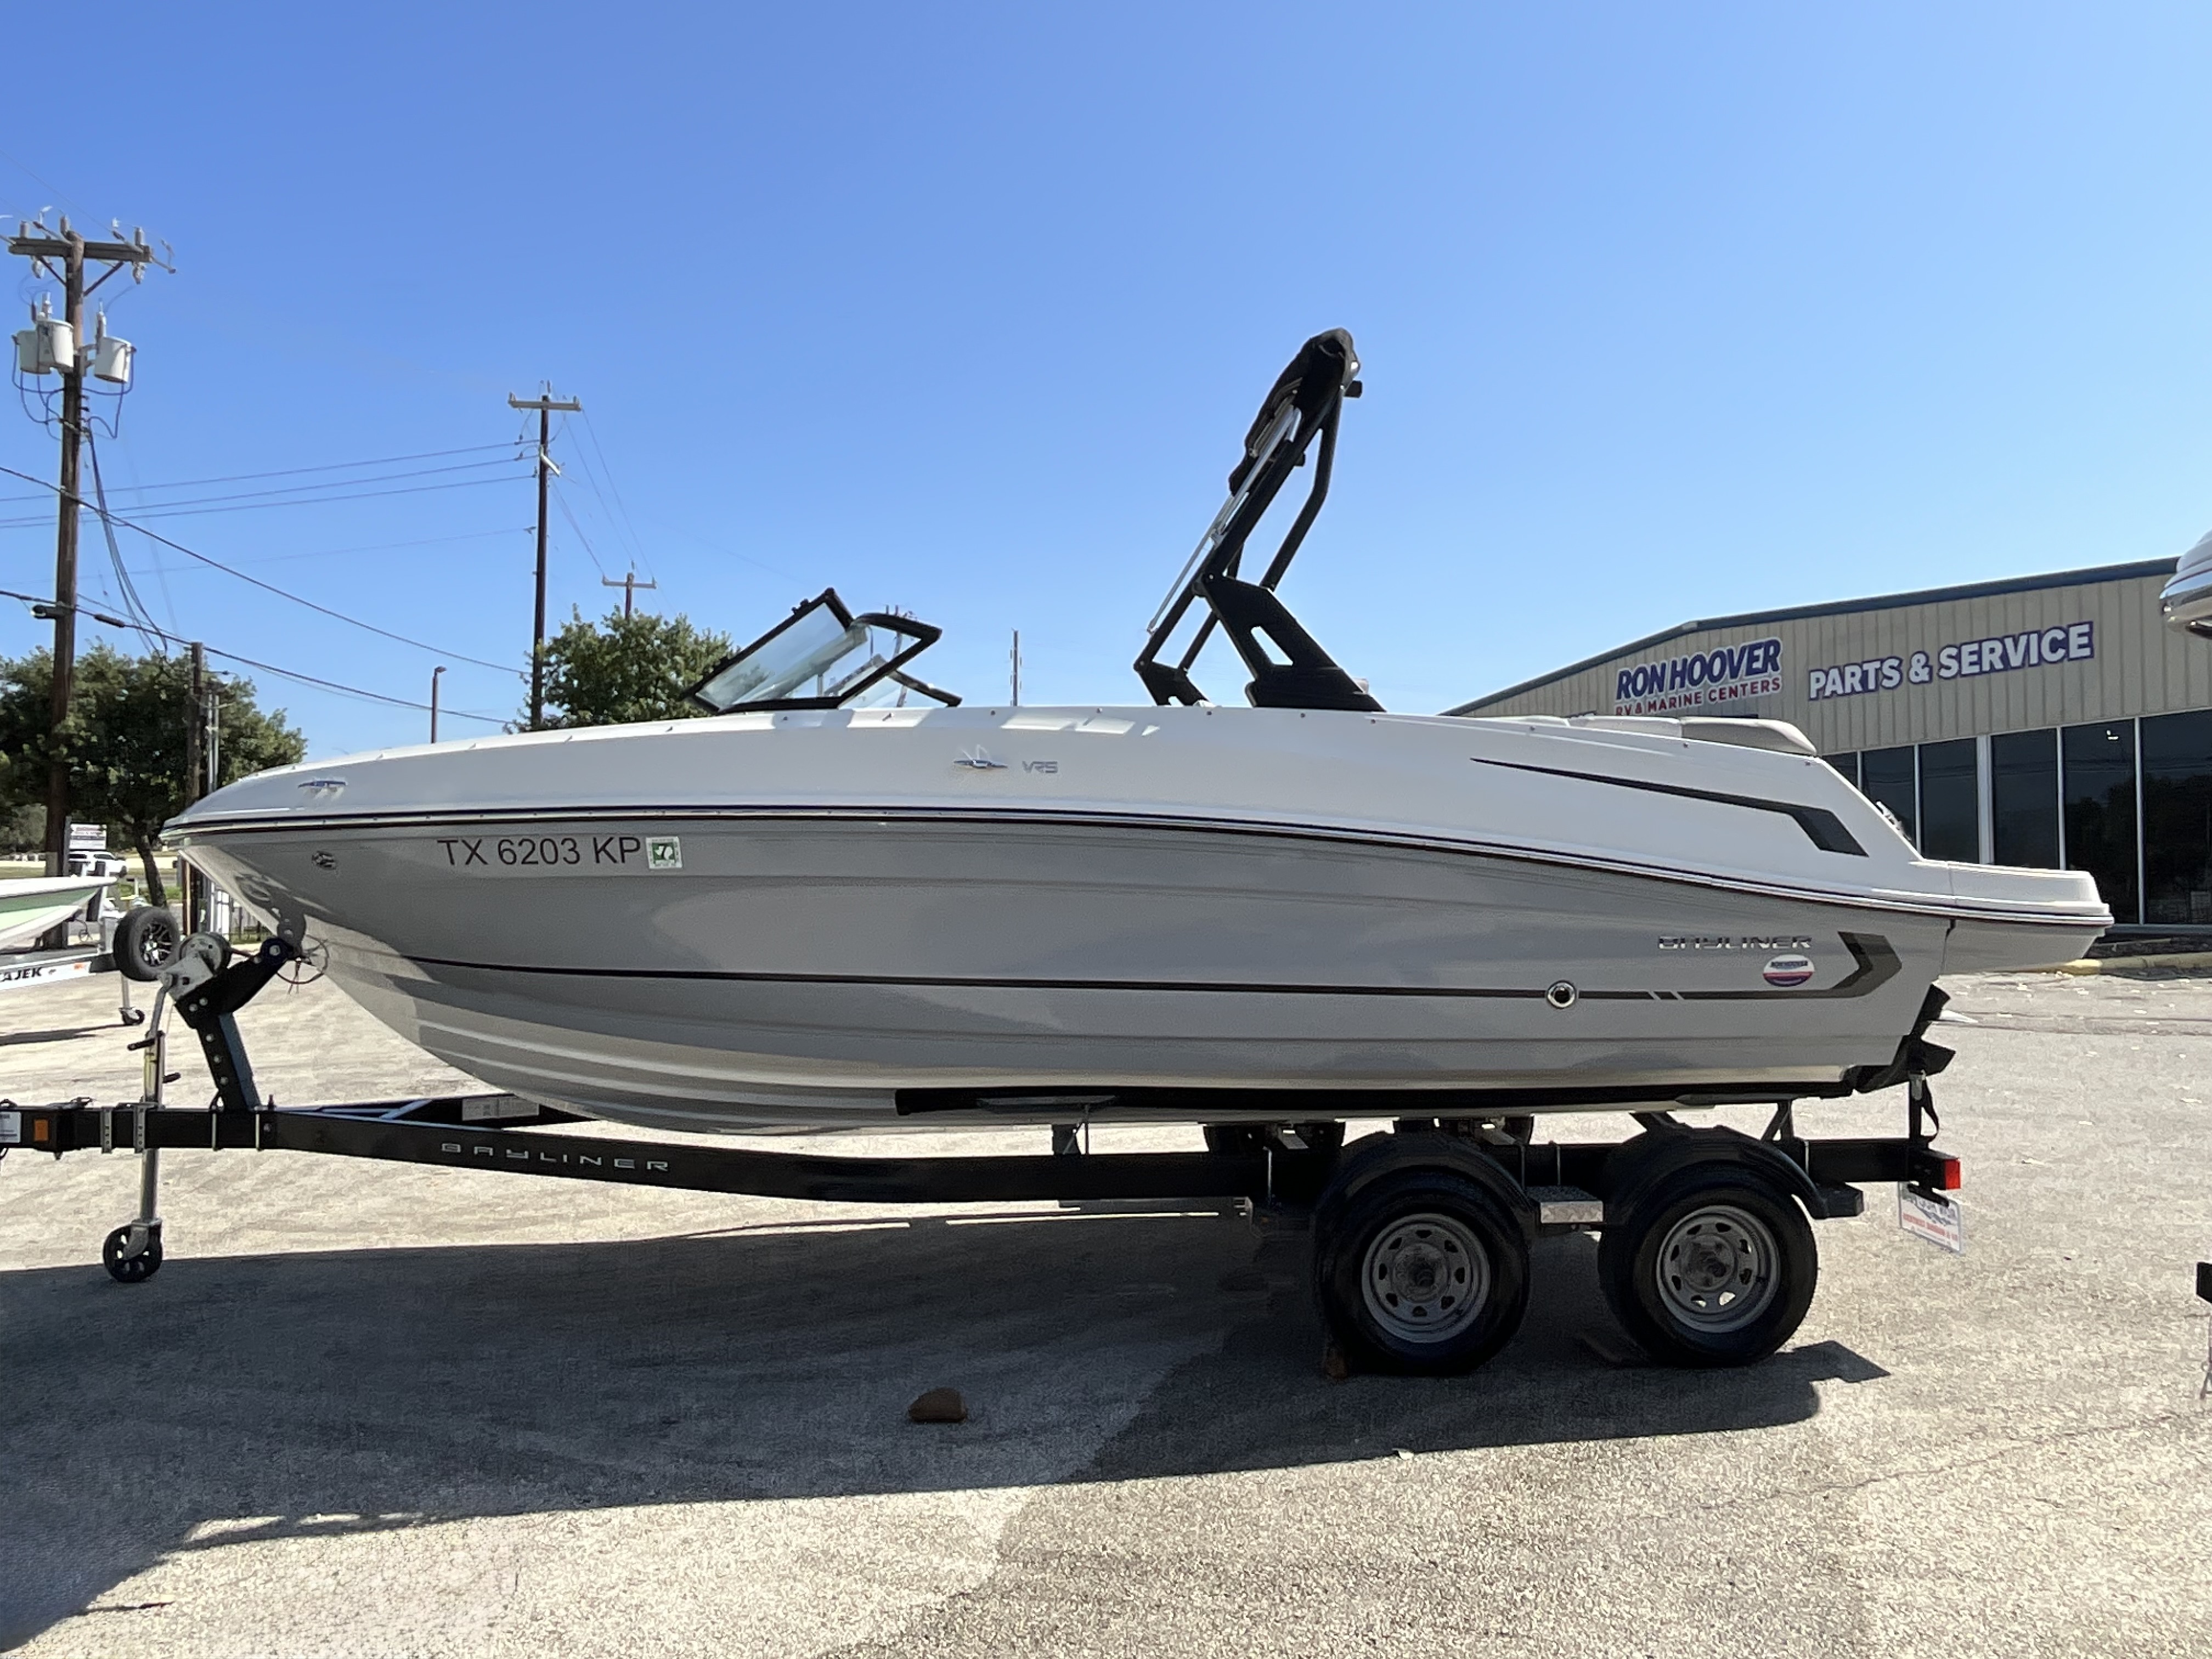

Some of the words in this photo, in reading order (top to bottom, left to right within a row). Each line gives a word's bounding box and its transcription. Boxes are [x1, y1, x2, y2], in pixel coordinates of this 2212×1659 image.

[1616, 662, 1667, 700] RON
[1669, 639, 1781, 690] HOOVER
[1809, 657, 1902, 700] PARTS
[1908, 652, 1932, 684] &
[1938, 622, 2092, 679] SERVICE
[1647, 691, 1702, 713] MARINE
[1708, 677, 1781, 702] CENTERS
[437, 838, 488, 865] TX
[498, 837, 580, 865] 6203
[593, 836, 641, 864] KP
[1658, 935, 1812, 949] BAYLINER
[0, 967, 42, 982] AJEK
[441, 1142, 669, 1172] BAYLINER
